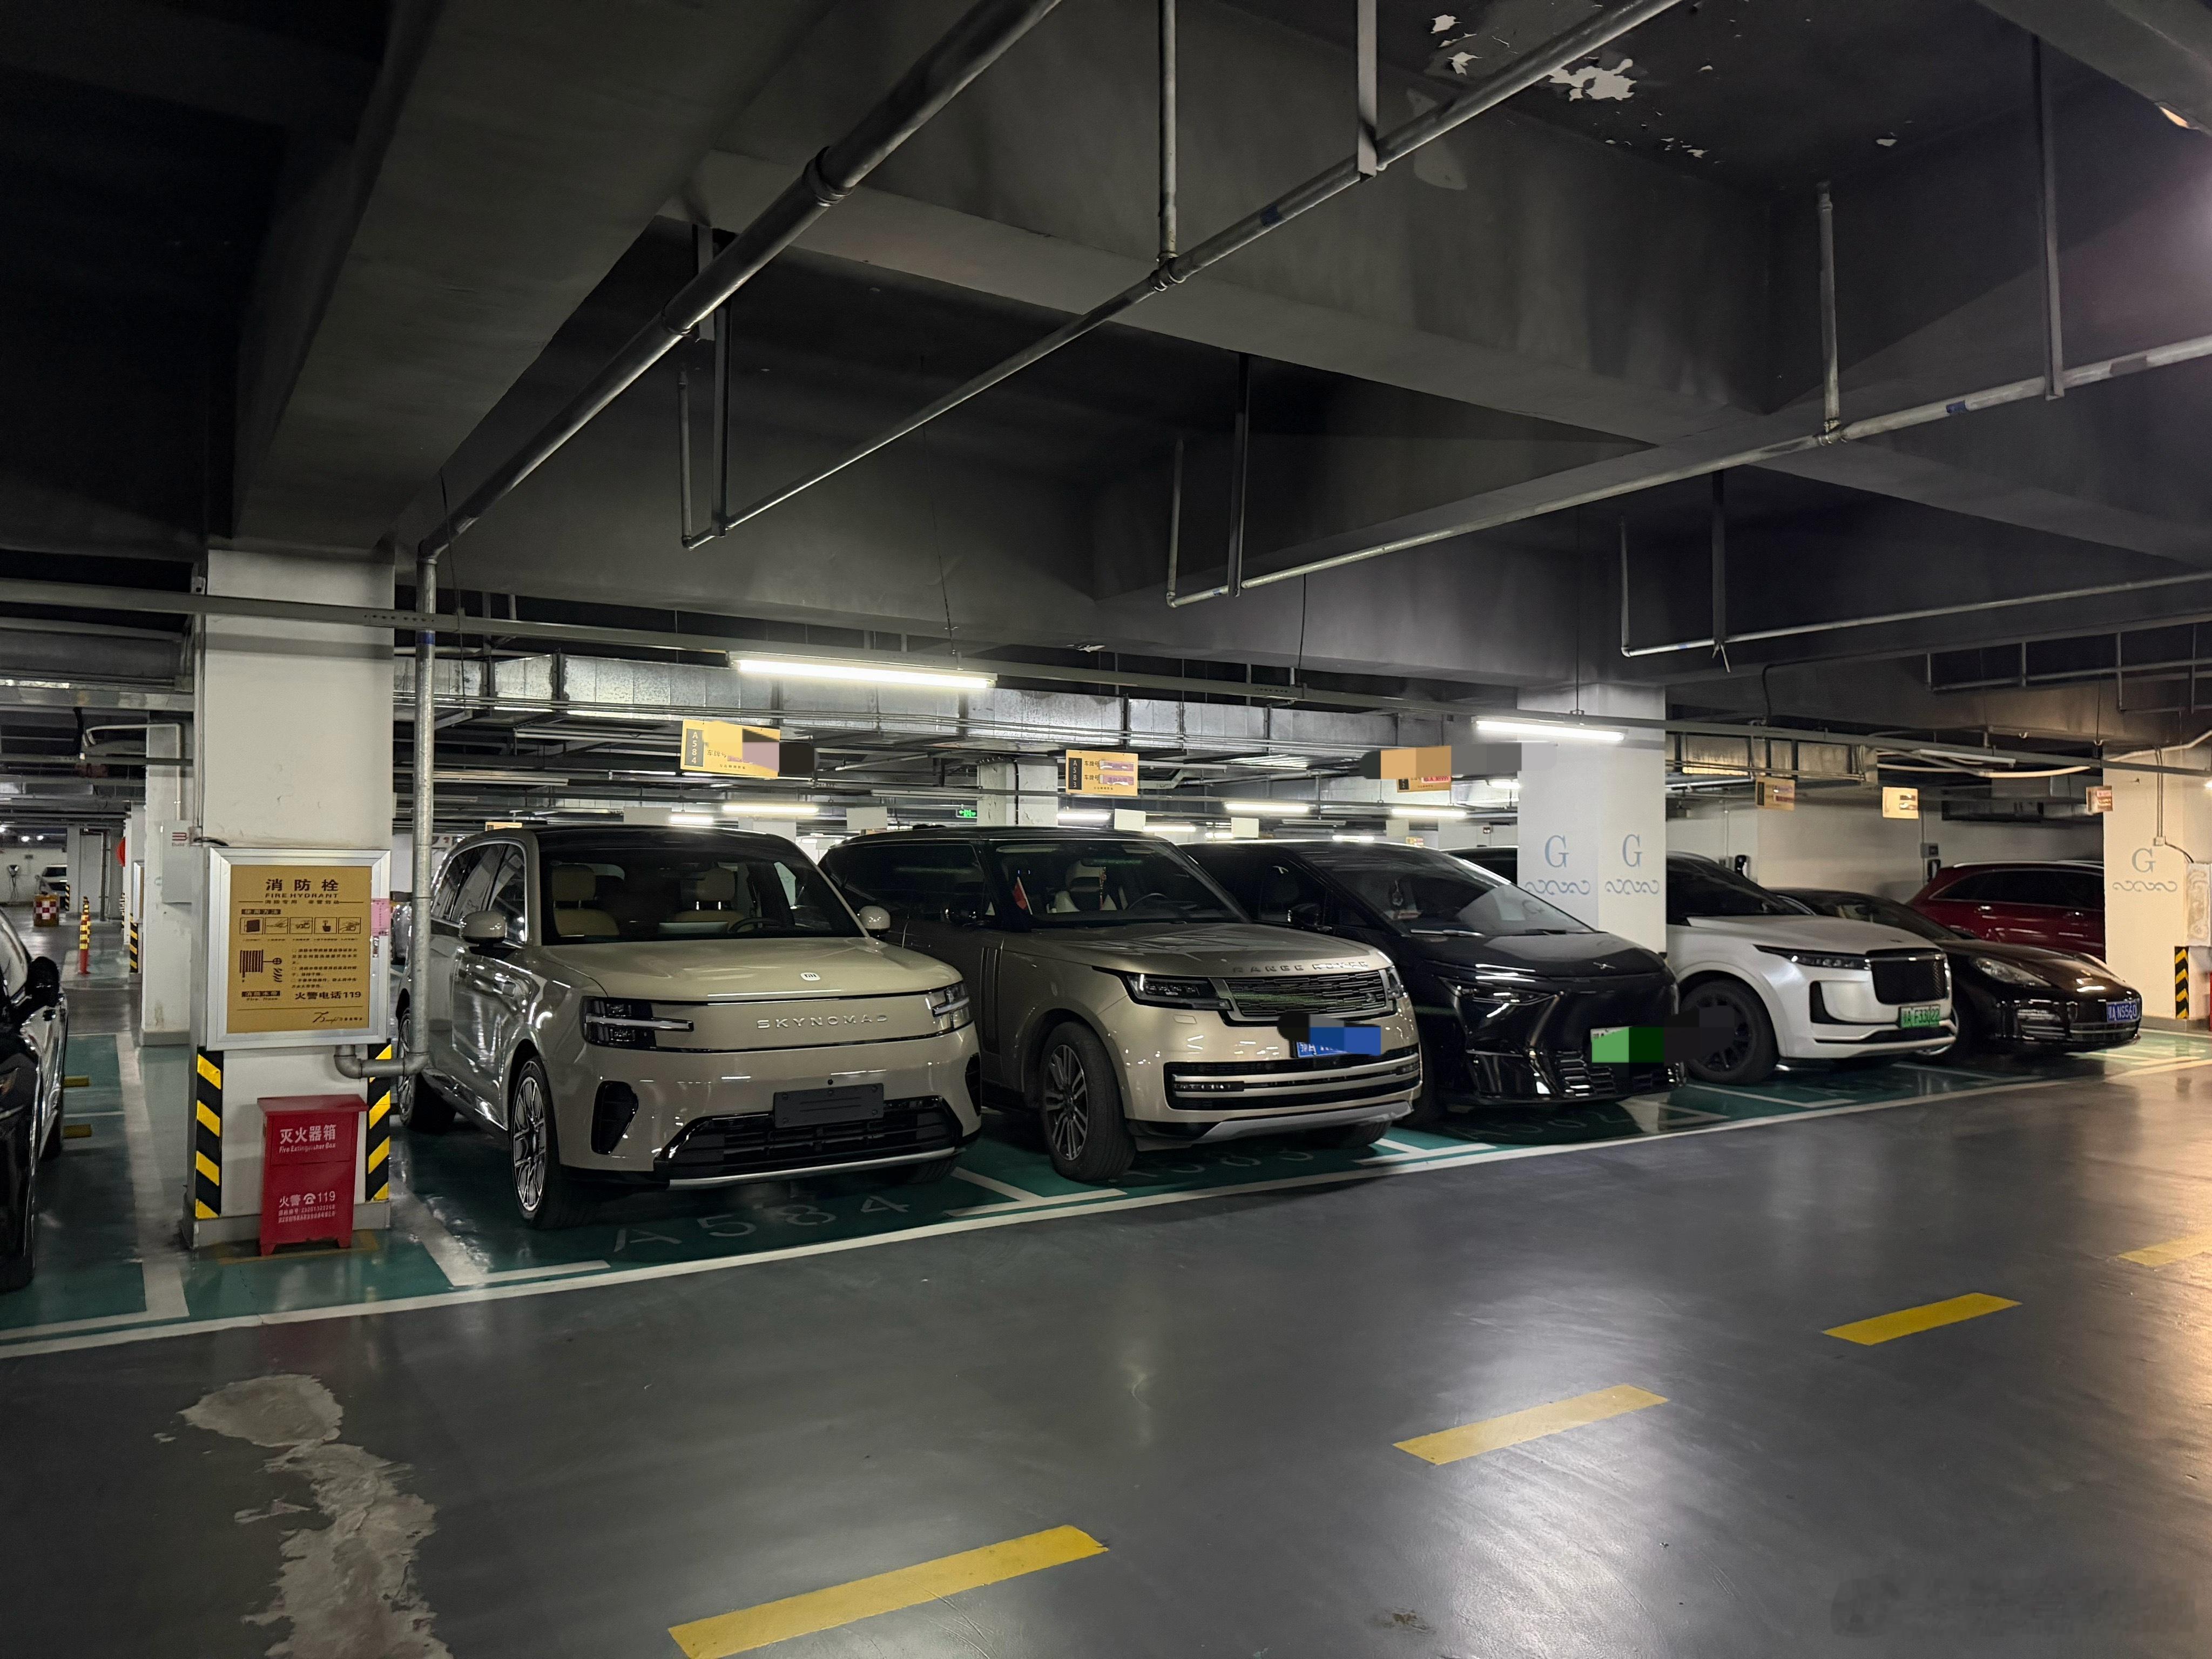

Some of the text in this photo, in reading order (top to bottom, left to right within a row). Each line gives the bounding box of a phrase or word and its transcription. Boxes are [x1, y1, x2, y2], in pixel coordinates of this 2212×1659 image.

[1545, 835, 1569, 868] G
[1622, 834, 1643, 867] G
[2131, 848, 2156, 872] G
[266, 878, 339, 891] 消防栓
[1233, 965, 1304, 973] RANGE
[295, 991, 361, 1000] 火警电话119
[757, 1014, 888, 1029] SKYNOMAD
[280, 1124, 336, 1145] 灭火器箱
[318, 1191, 336, 1203] 119
[613, 1195, 910, 1252] A584
